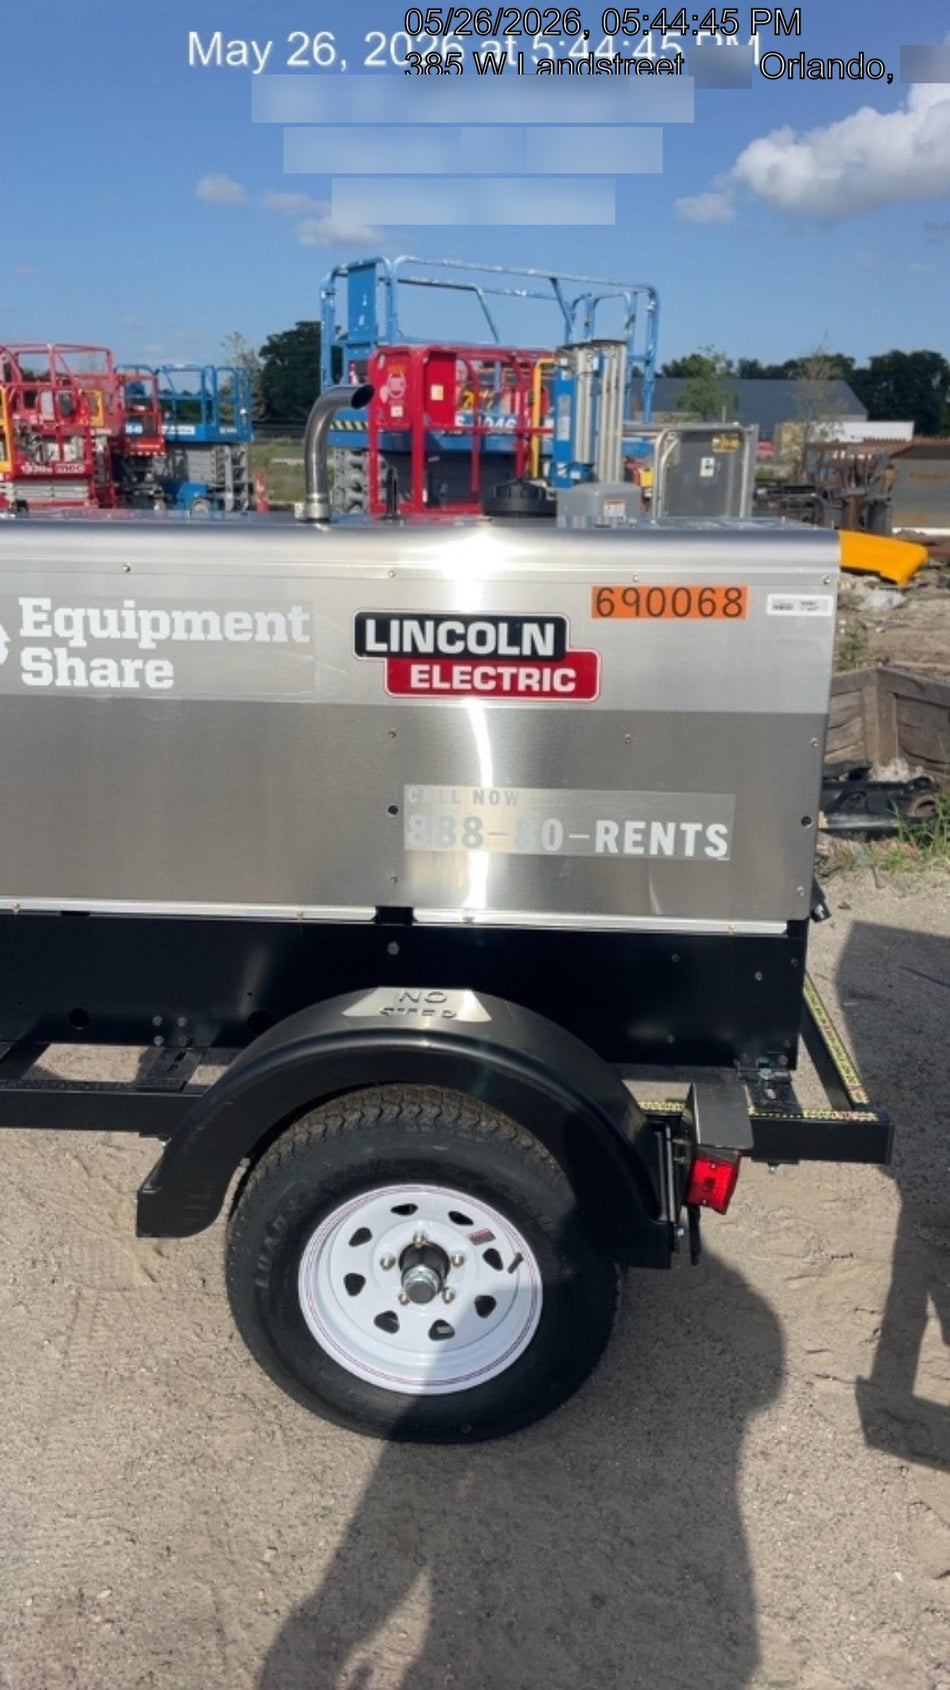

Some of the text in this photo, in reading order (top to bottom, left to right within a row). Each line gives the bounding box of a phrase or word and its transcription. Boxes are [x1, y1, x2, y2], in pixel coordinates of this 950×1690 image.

[595, 586, 743, 618] 690068
[18, 597, 311, 649] Equipment
[365, 619, 555, 656] LINCOLN
[20, 647, 175, 689] Share
[410, 664, 577, 692] ELECTRIC
[472, 789, 520, 806] NOW
[399, 991, 447, 1004] NO
